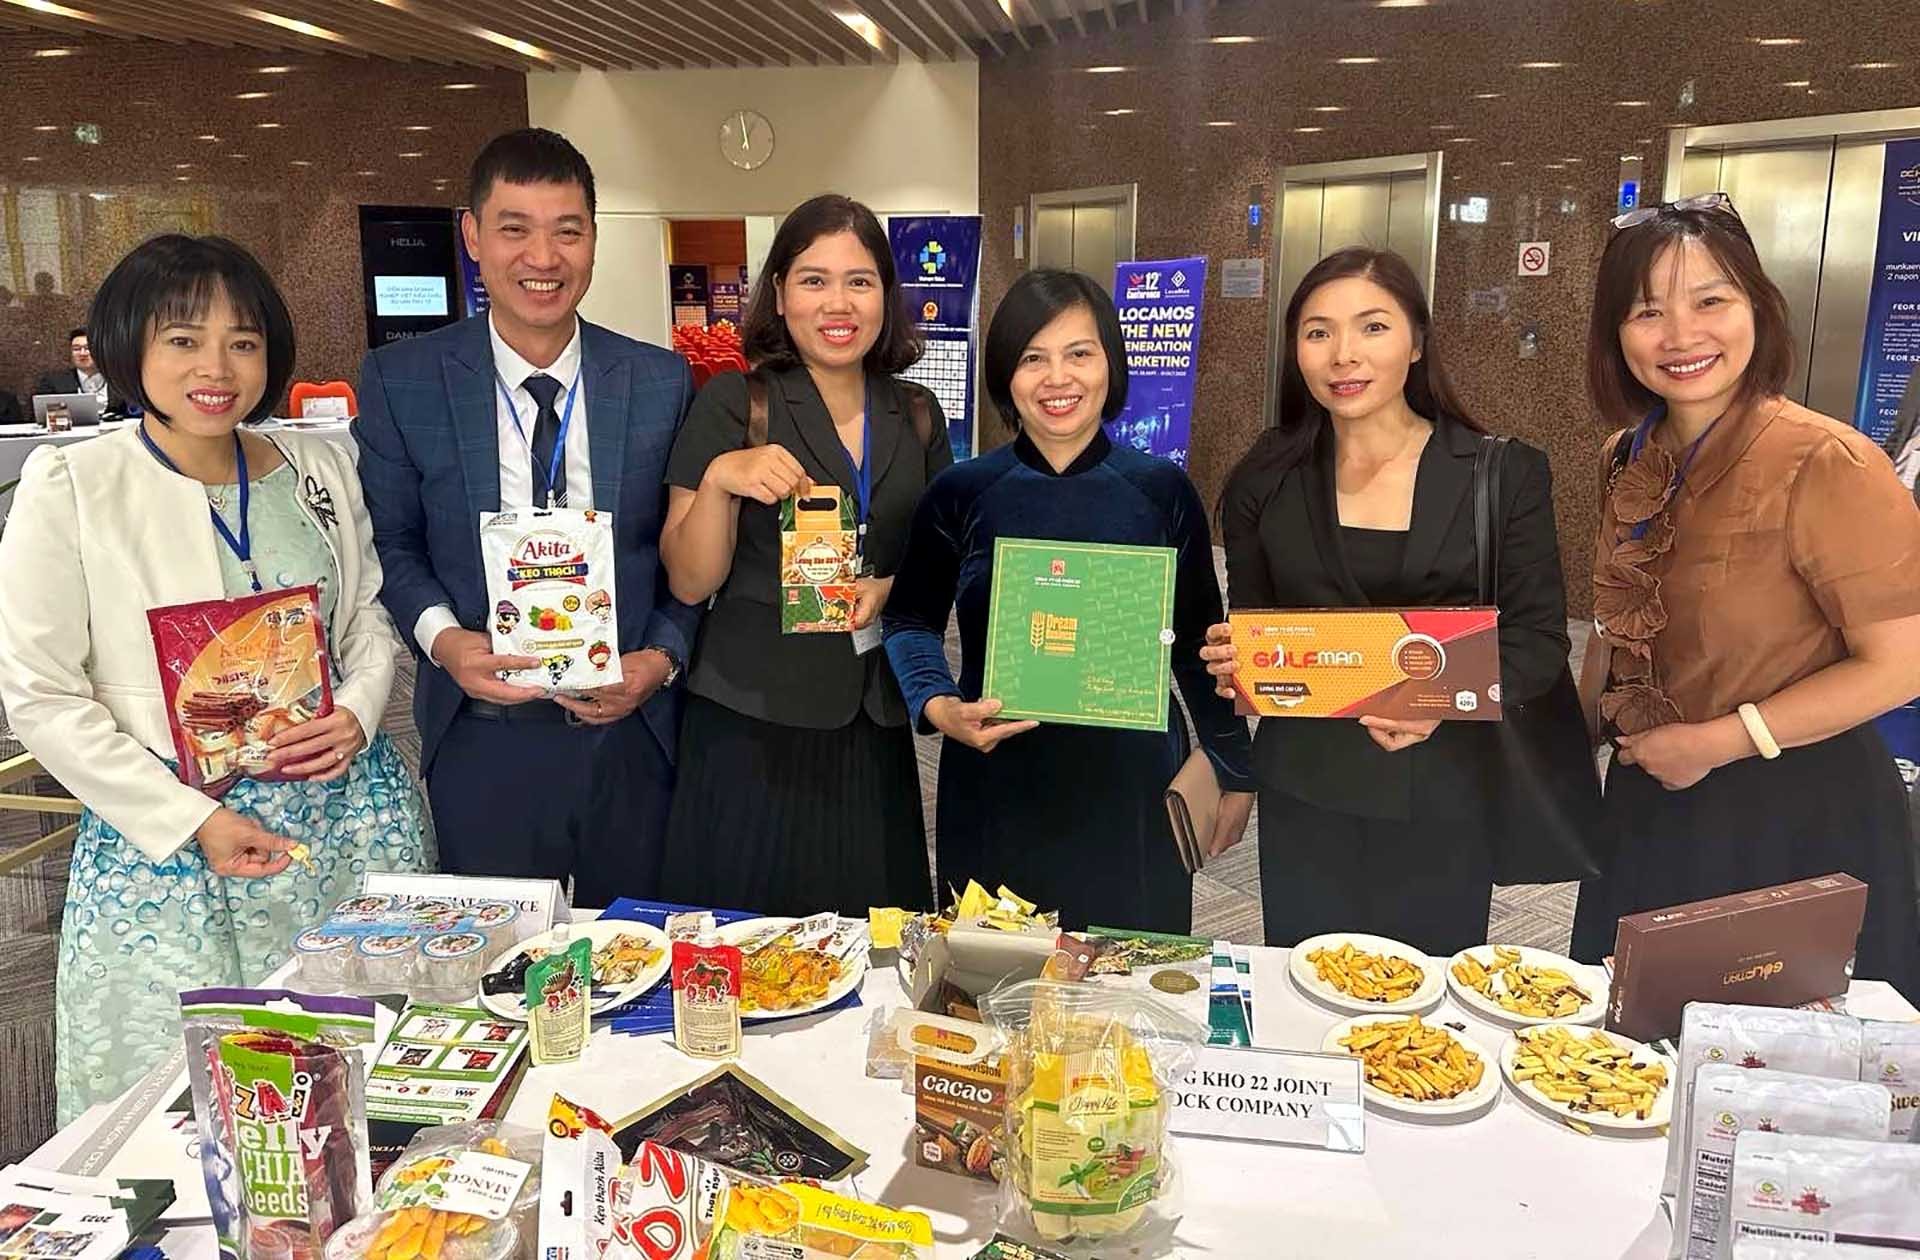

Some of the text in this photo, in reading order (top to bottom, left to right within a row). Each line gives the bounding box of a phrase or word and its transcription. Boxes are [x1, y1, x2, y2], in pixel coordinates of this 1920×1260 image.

[1118, 306, 1195, 321] LOCAMOS
[1120, 323, 1194, 338] THE NEW
[1124, 341, 1192, 351] ENERATION
[1127, 356, 1190, 368] ARKETING
[522, 541, 571, 560] Akita
[922, 1073, 993, 1104] cacao
[1183, 1070, 1332, 1096] G KHO 22 JOINT
[1173, 1092, 1313, 1118] OCK COMPANY
[239, 1121, 332, 1160] elly
[242, 1149, 308, 1185] CHIA
[1701, 1153, 1732, 1165] Nutri
